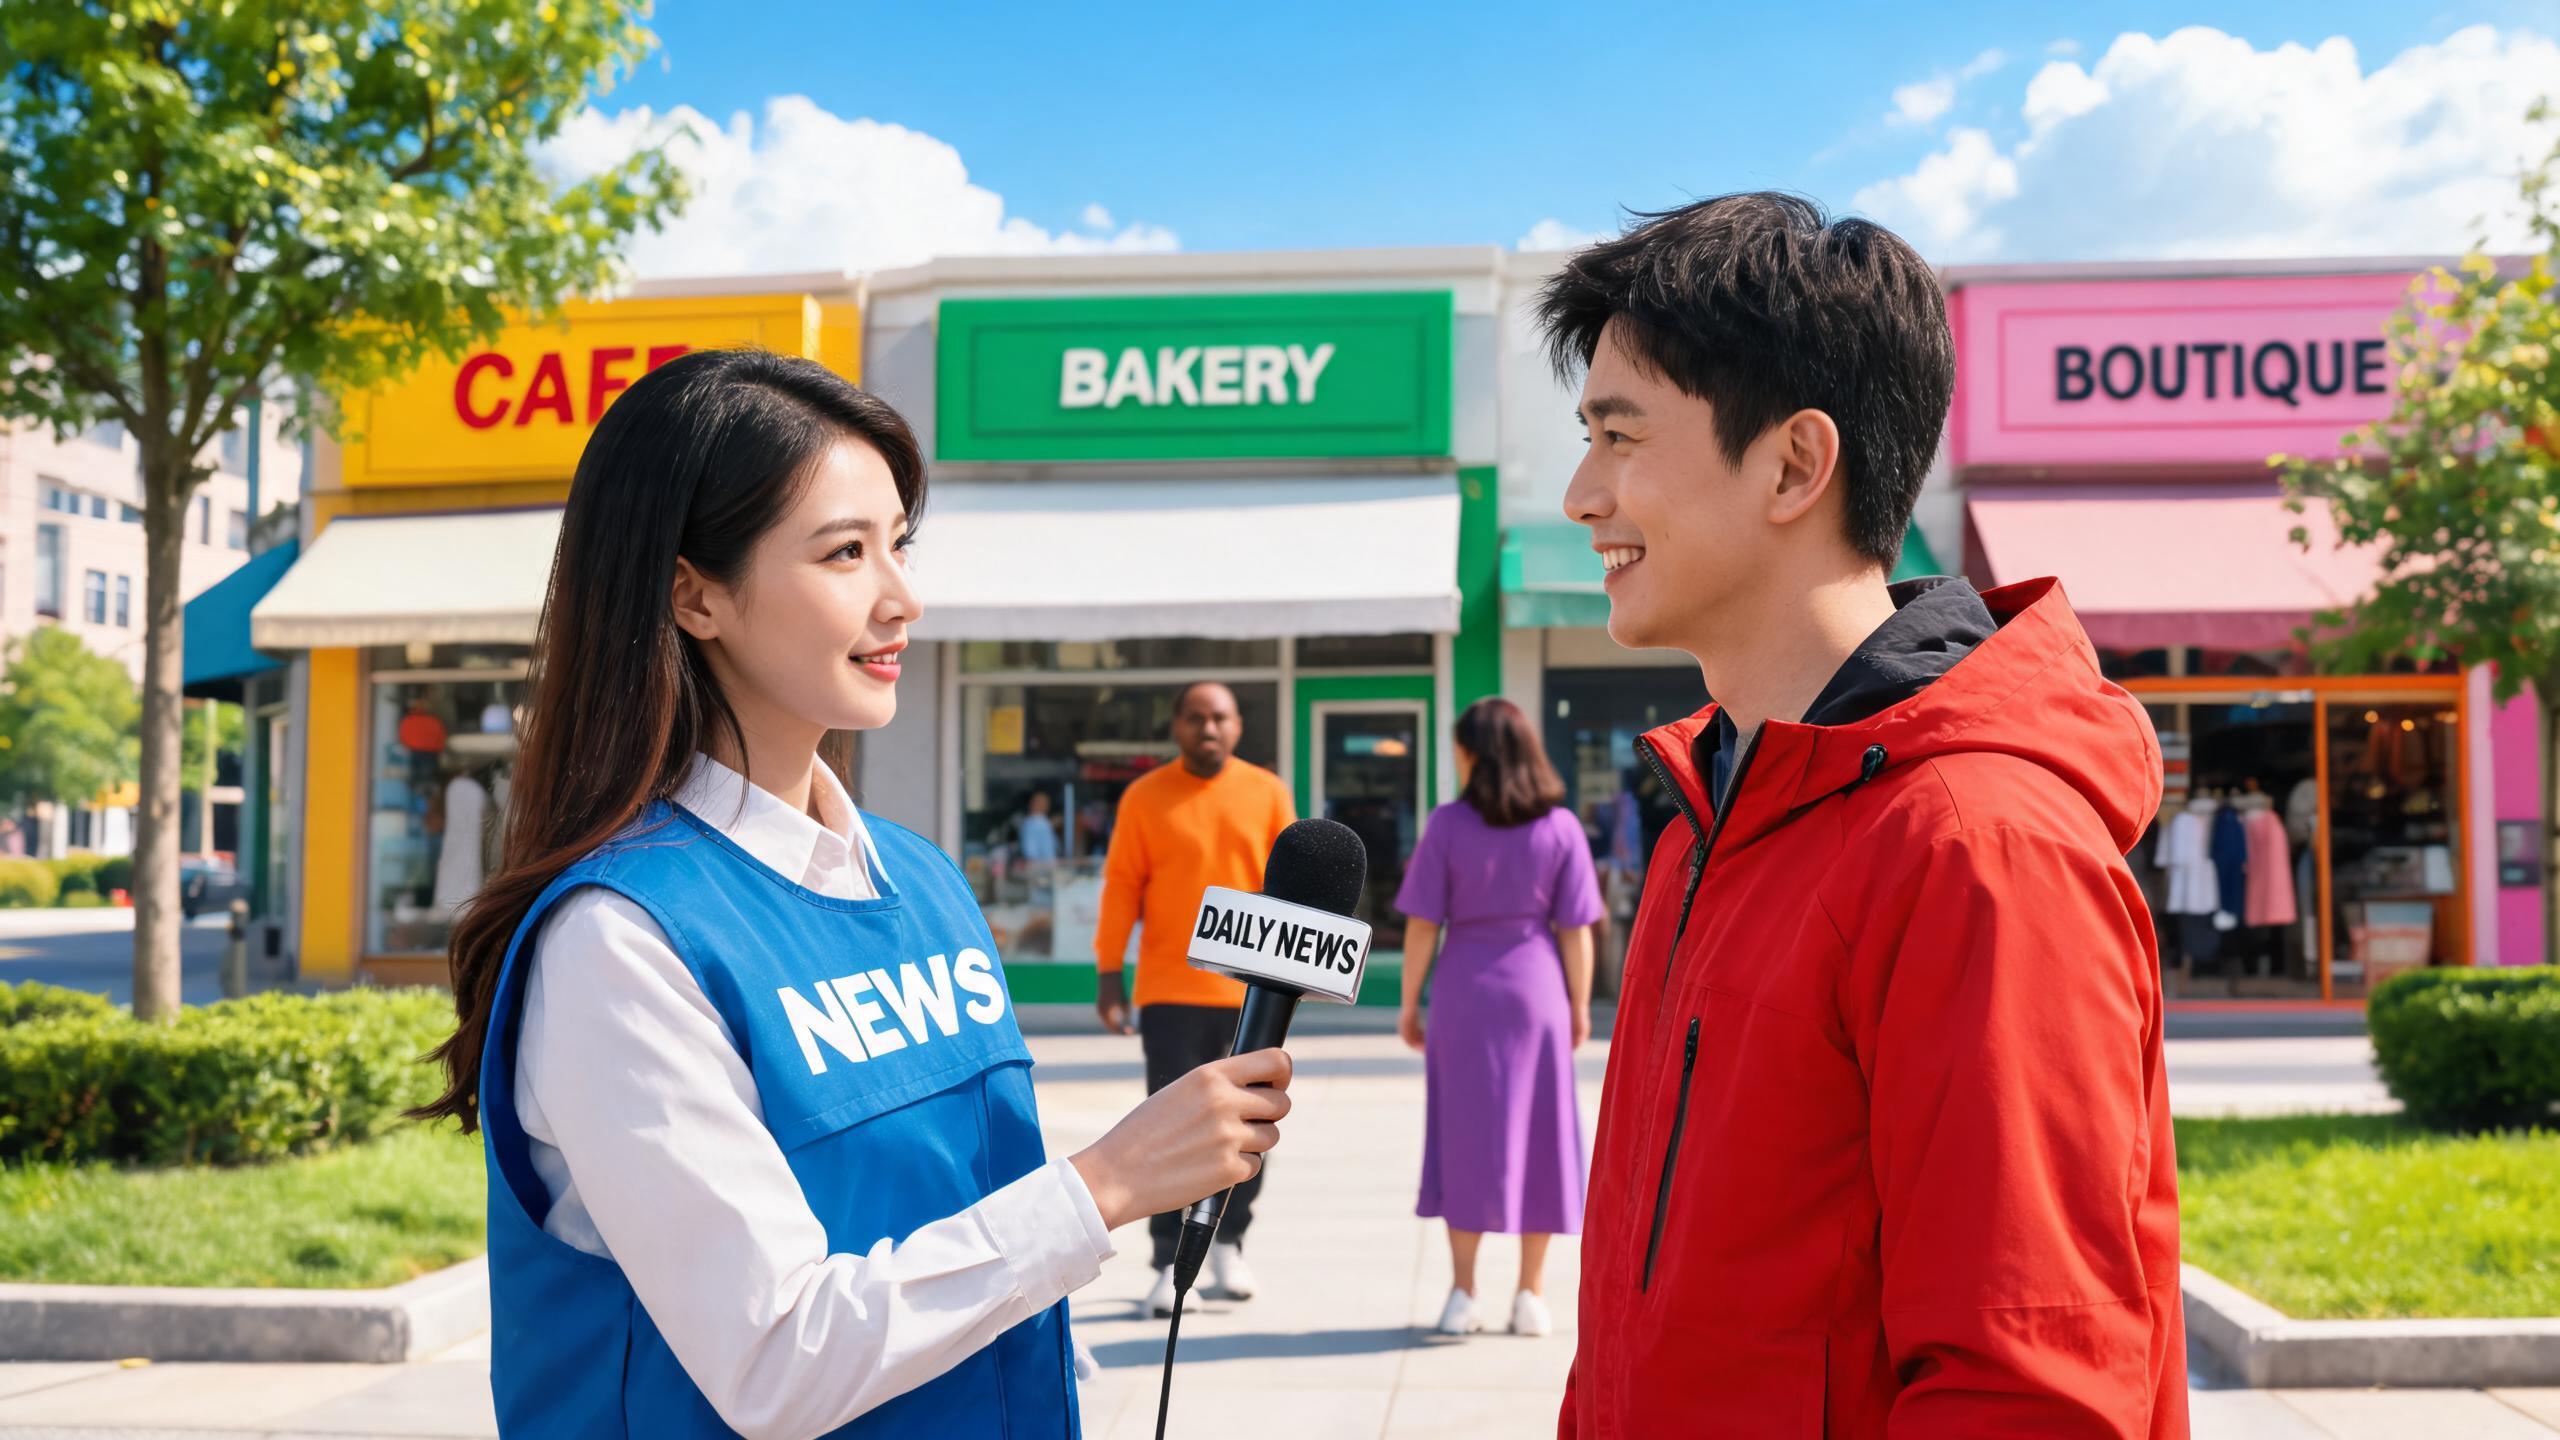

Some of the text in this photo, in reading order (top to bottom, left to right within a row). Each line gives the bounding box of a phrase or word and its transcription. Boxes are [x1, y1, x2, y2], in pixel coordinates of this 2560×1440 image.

[454, 345, 691, 430] CAF
[1059, 343, 1336, 408] BAKERY
[2056, 341, 2387, 407] BOUTIQUE
[1196, 905, 1359, 975] DAILY NEWS
[776, 947, 1005, 1076] NEWS
